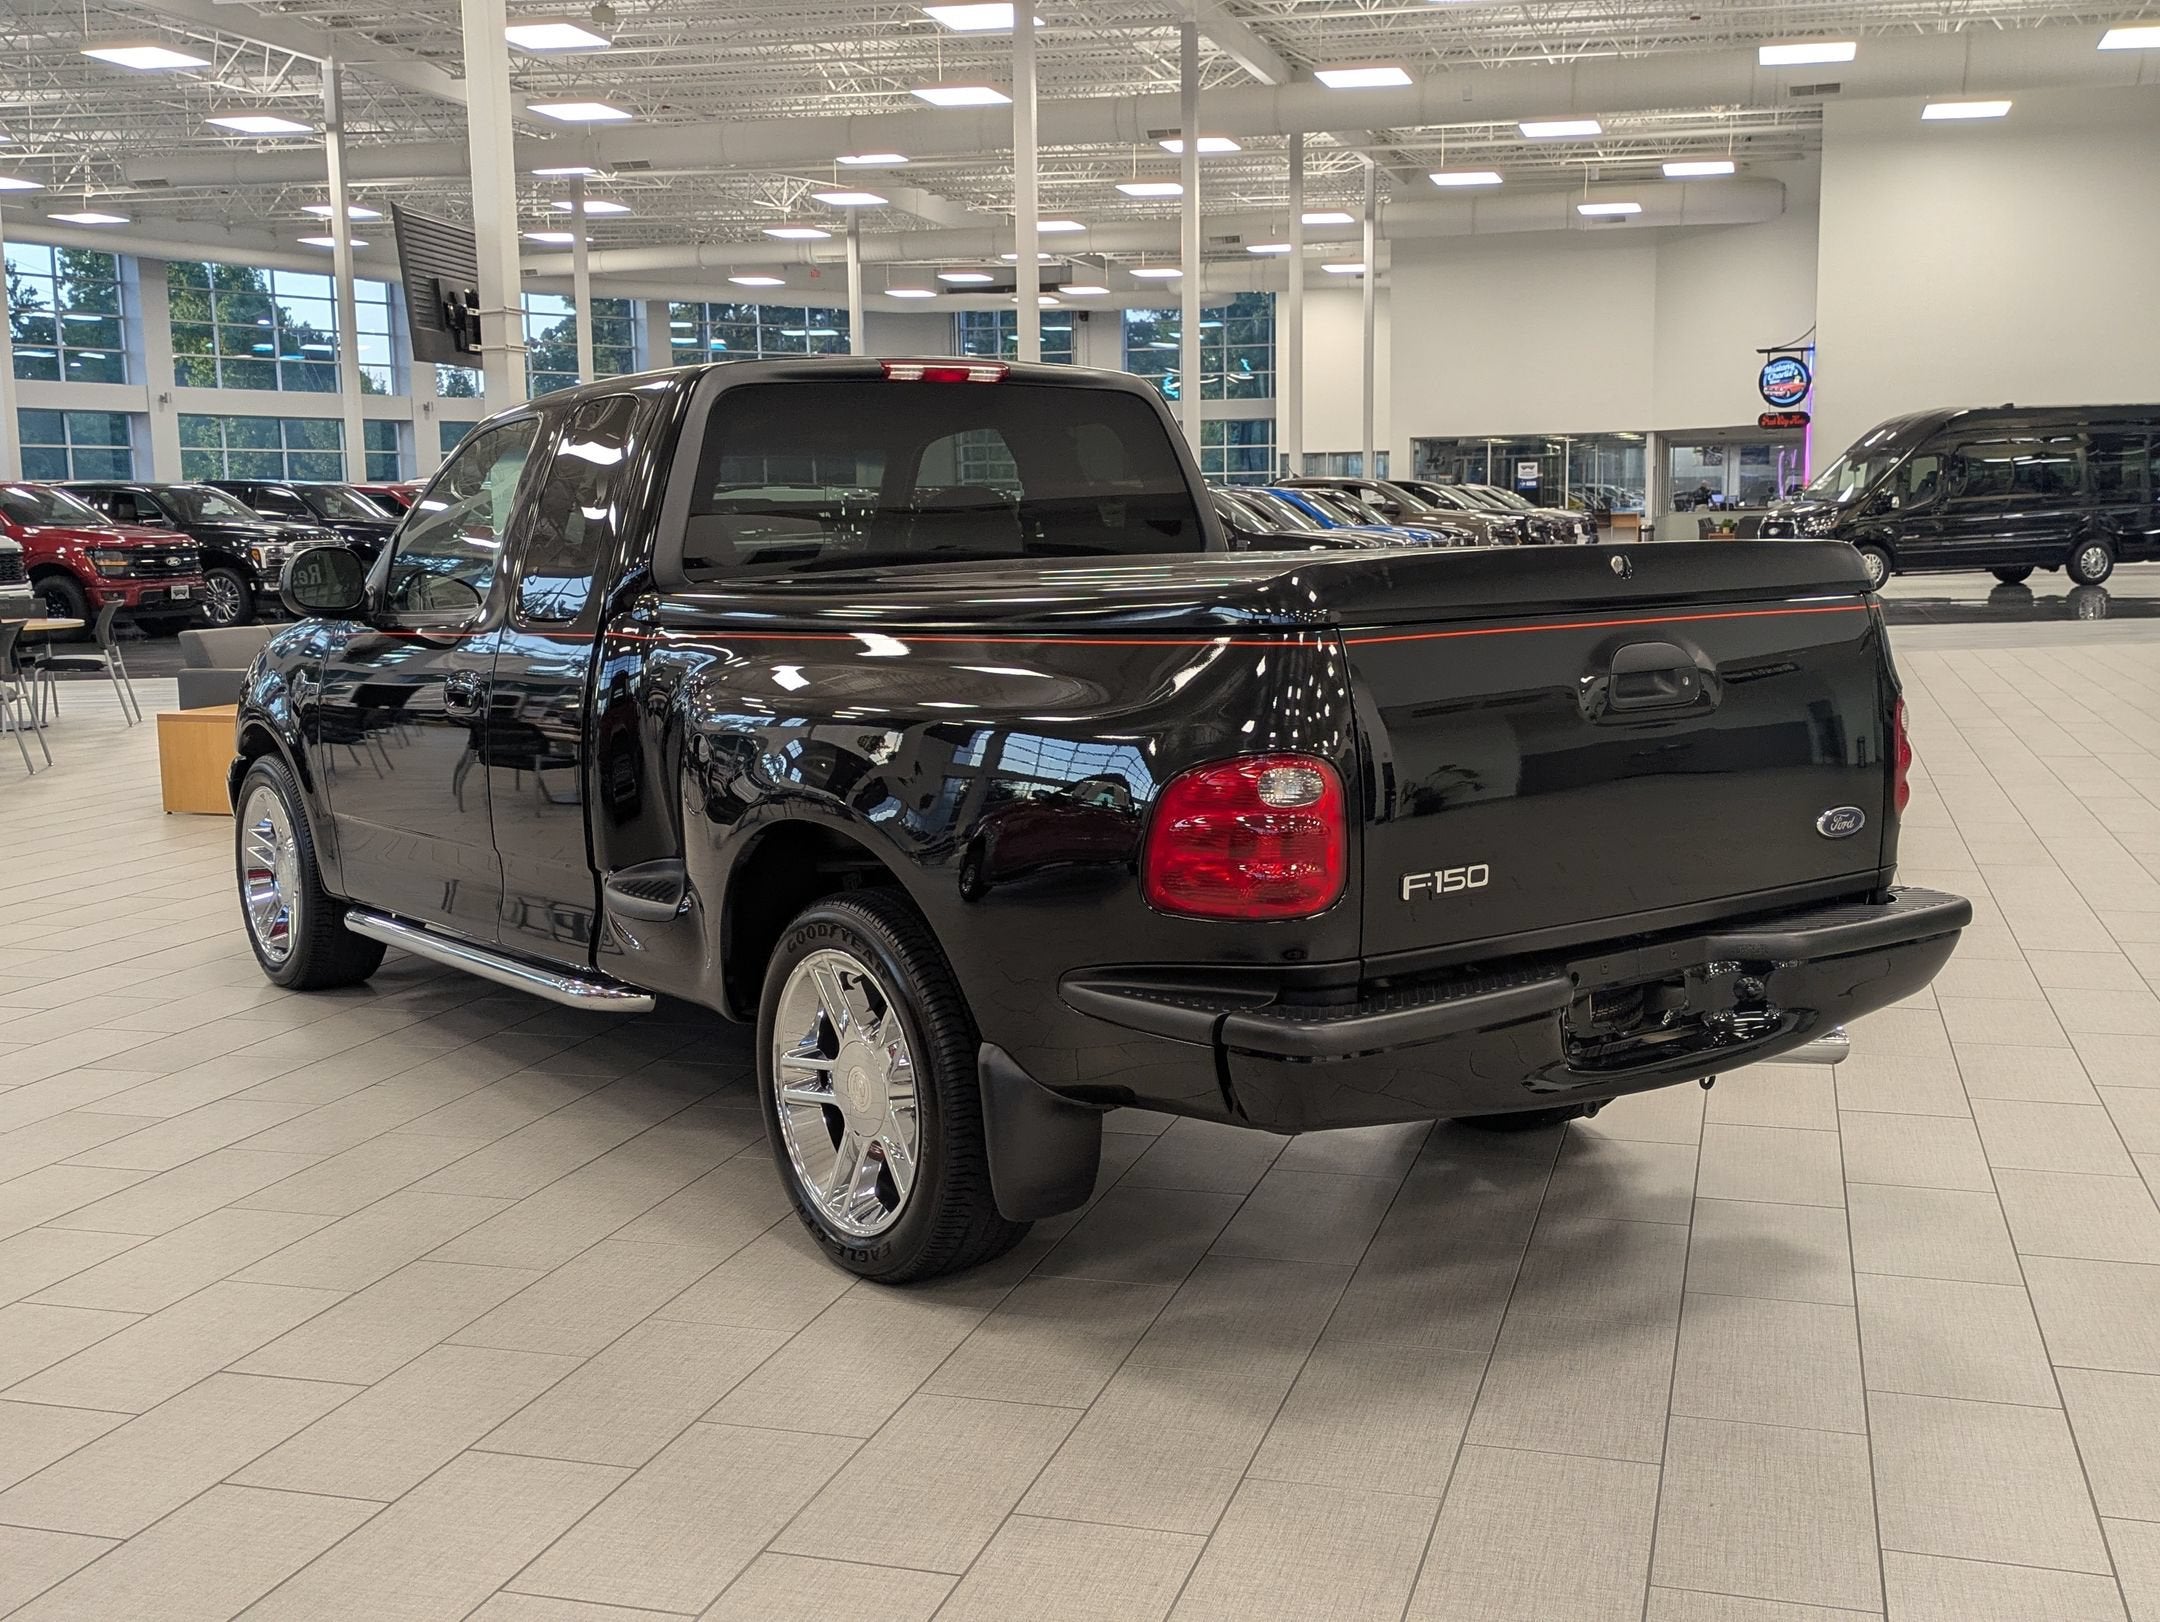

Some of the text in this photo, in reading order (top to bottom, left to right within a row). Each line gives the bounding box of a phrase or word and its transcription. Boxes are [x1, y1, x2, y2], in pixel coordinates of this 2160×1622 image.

[1830, 813, 1855, 831] Ford
[1403, 864, 1489, 900] F-150
[787, 924, 887, 980] GOODYEAR
[833, 1241, 892, 1262] EAGLE
